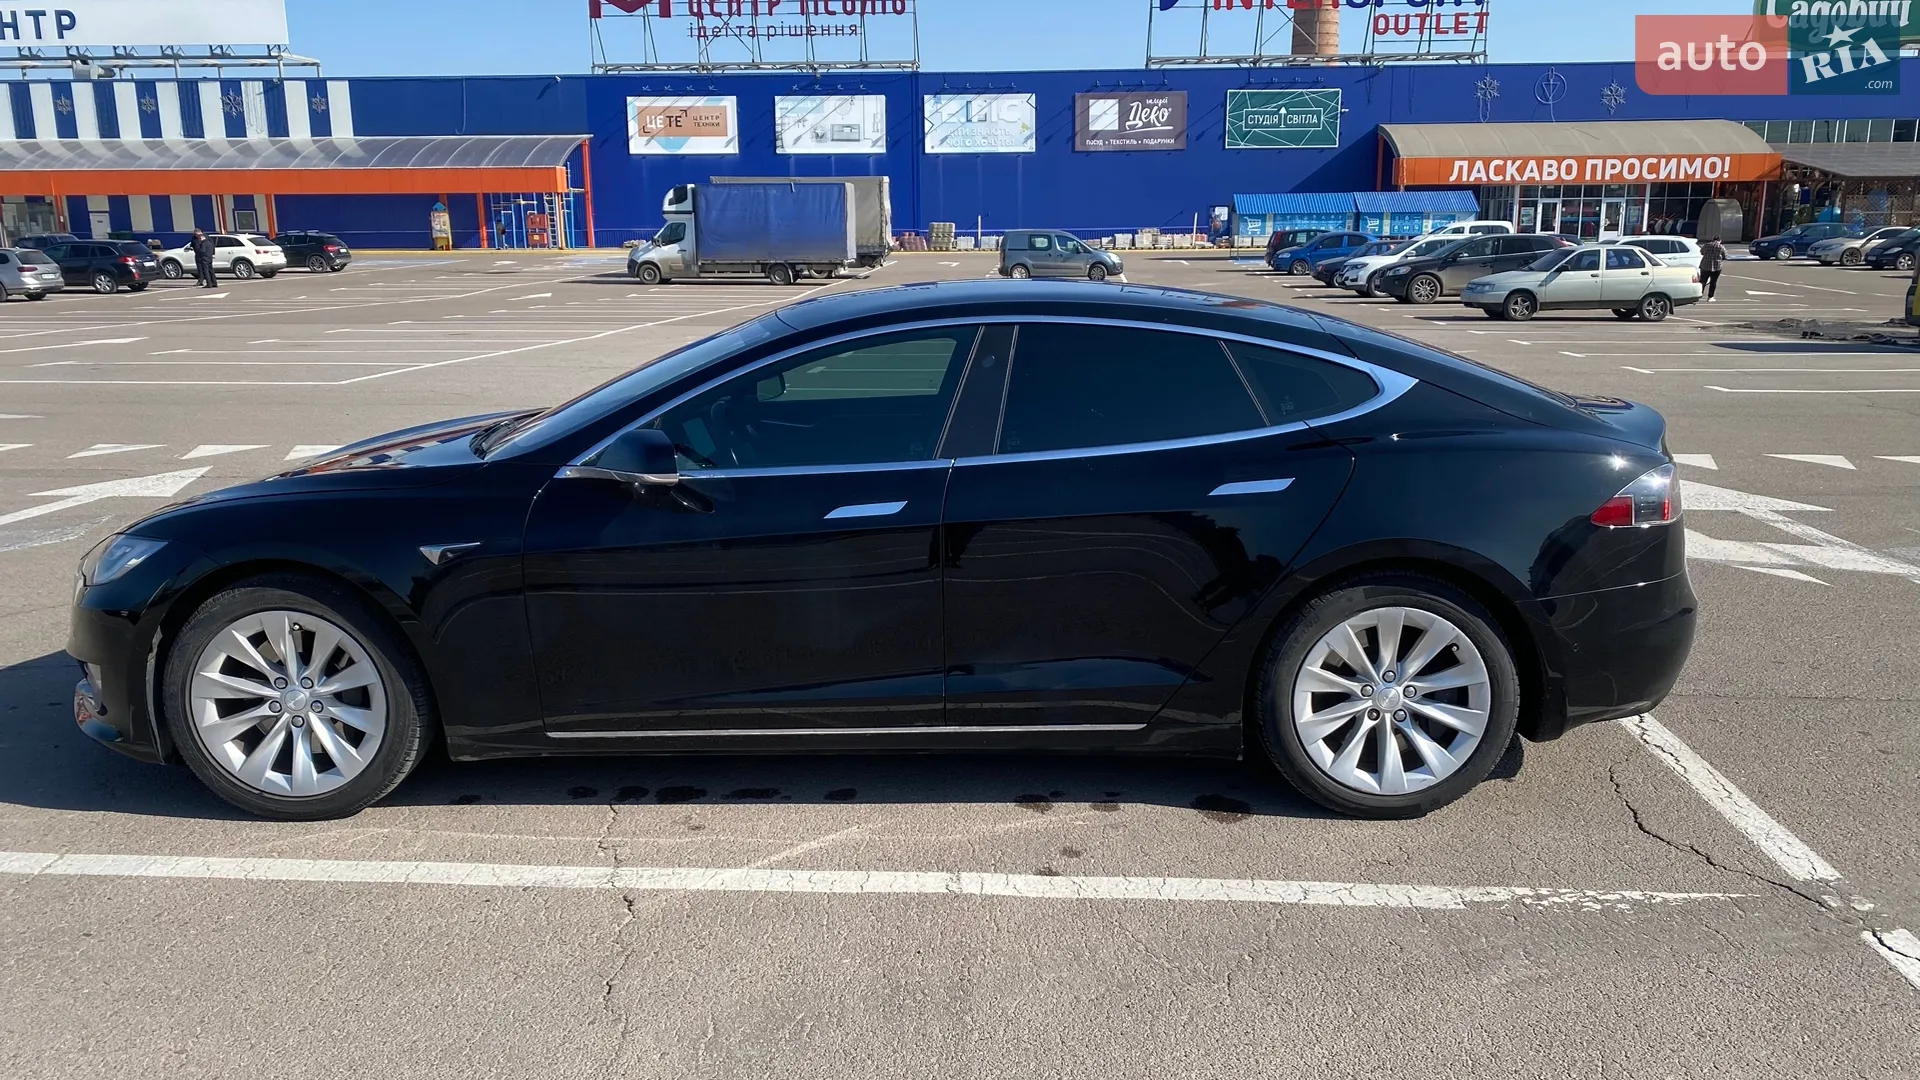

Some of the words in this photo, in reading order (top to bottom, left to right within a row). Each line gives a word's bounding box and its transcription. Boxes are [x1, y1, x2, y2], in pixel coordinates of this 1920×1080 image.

[766, 21, 858, 41] рішення
[1373, 12, 1490, 35] OUTLET
[1247, 114, 1279, 125] СТУДІЯ
[1286, 114, 1318, 124] СВІТЛА
[1449, 158, 1579, 182] ЛАСКАВО
[1584, 156, 1731, 181] ПРОСИМО!
